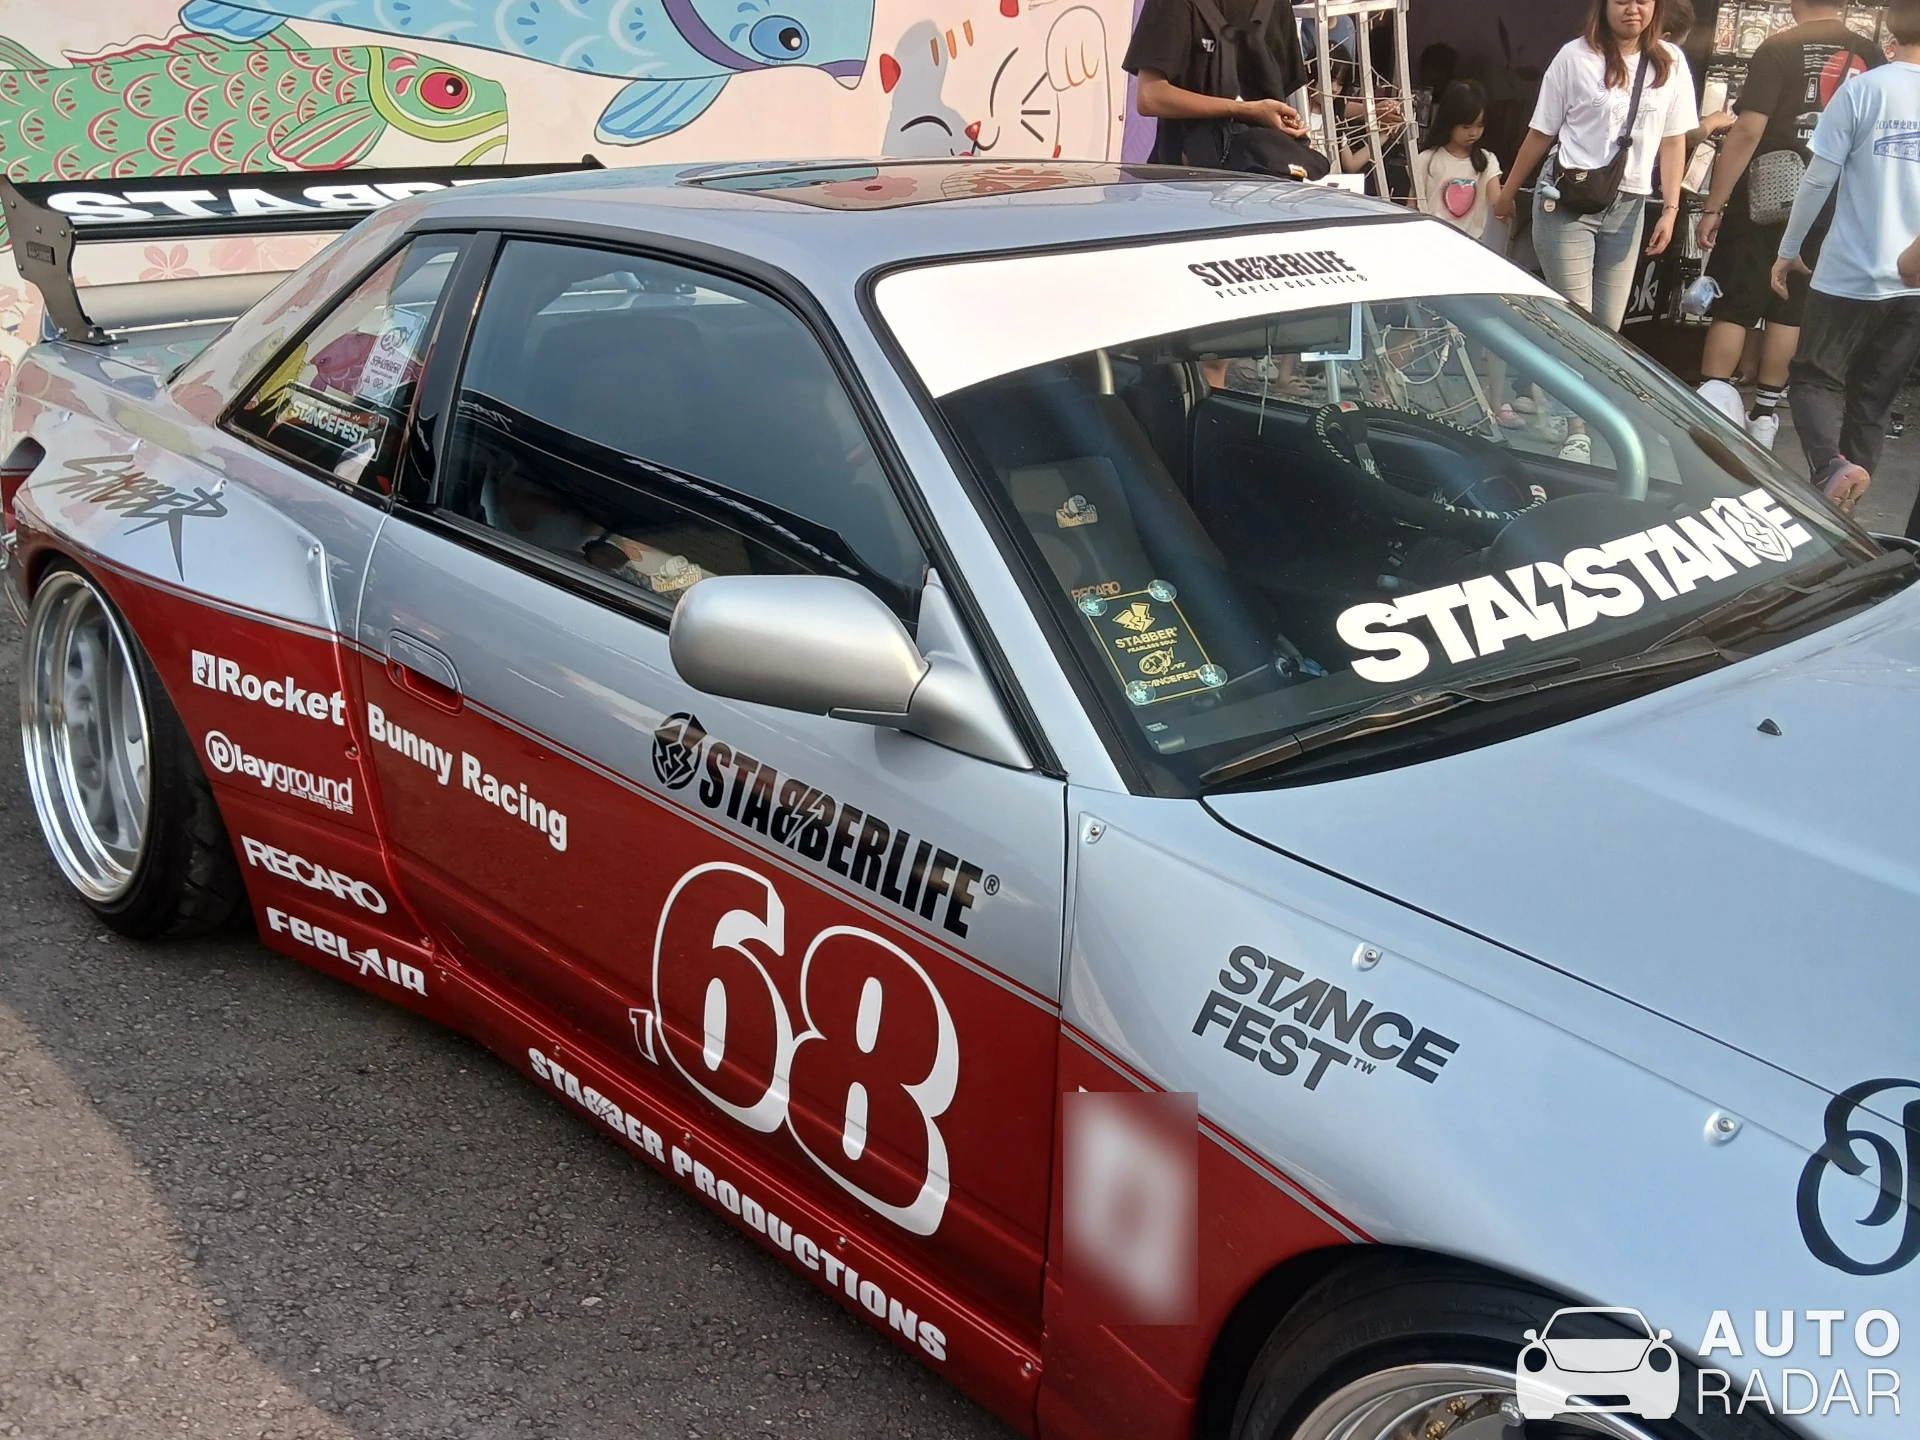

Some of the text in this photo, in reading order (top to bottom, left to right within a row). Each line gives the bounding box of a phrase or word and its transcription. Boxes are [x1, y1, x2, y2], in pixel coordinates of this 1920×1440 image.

[205, 730, 353, 808] playground
[218, 656, 568, 852] Rocket Bunny Racing
[240, 835, 388, 915] RECARO
[1192, 989, 1354, 1092] FEST
[1219, 945, 1461, 1084] STANCE
[672, 1144, 948, 1361] PRODUCTIONS
